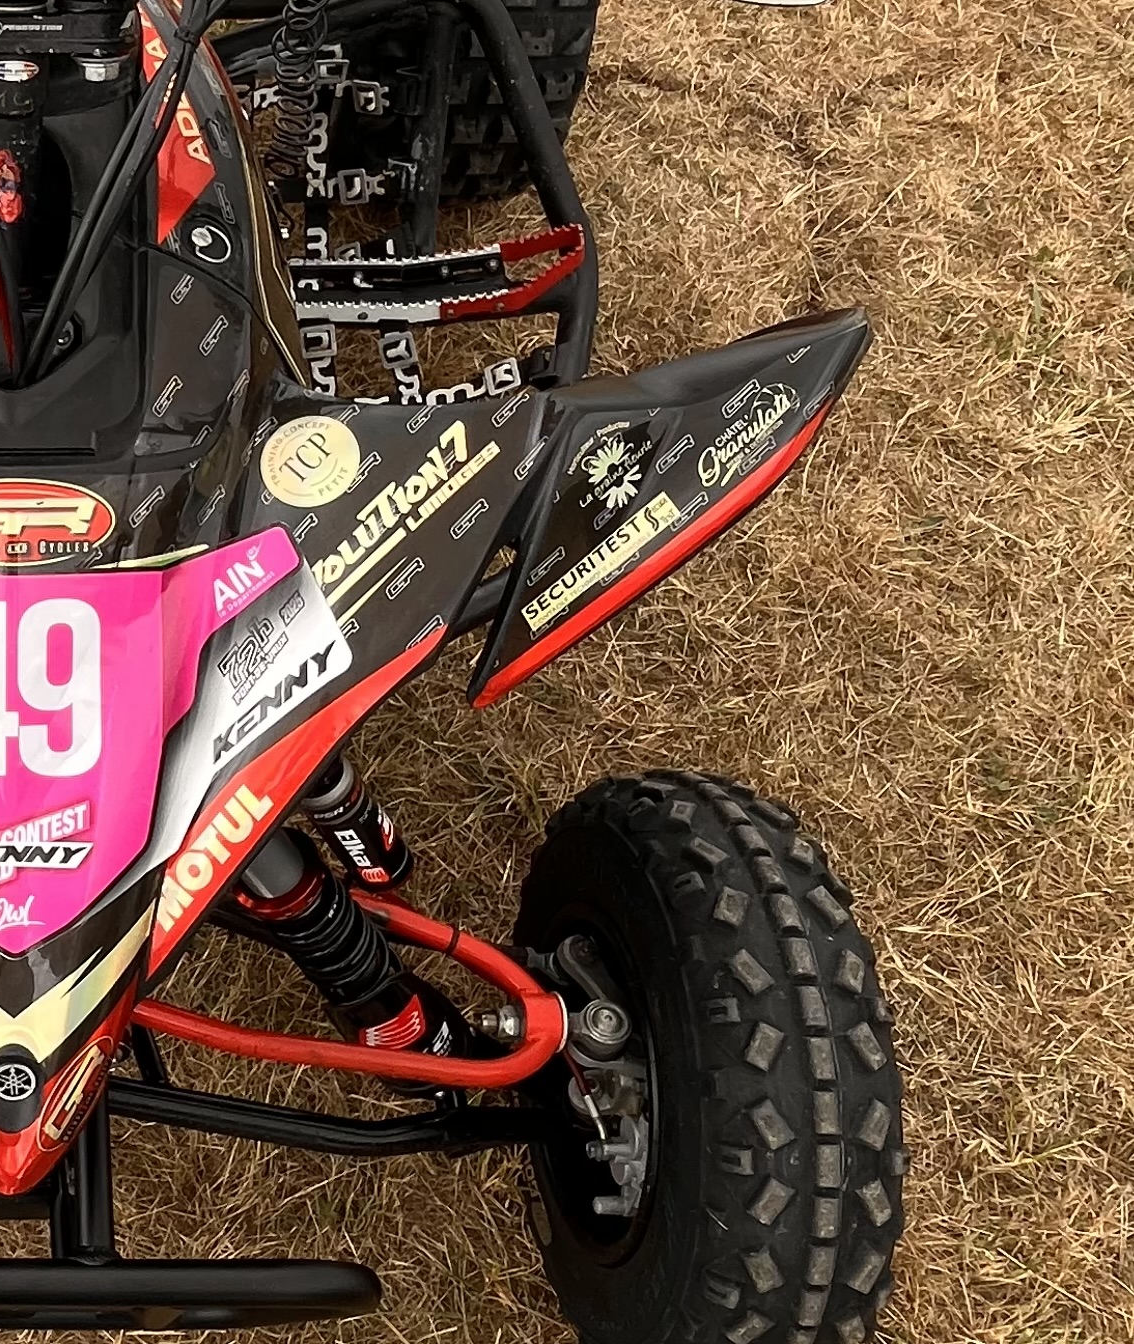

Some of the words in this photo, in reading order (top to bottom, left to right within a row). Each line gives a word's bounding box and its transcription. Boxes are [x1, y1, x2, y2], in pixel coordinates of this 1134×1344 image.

[267, 438, 283, 487] TRAINING
[283, 421, 332, 438] CONCEPT
[279, 432, 332, 483] TCP
[318, 466, 348, 496] PETIT
[406, 441, 501, 532] LIMOGES
[39, 541, 89, 554] CYCLES
[525, 516, 641, 620] SECURITEST
[213, 560, 266, 612] AIN
[213, 640, 336, 764] KENNY
[0, 804, 87, 842] CONTEST
[334, 829, 373, 868] Elka
[157, 784, 274, 933] MOTUL
